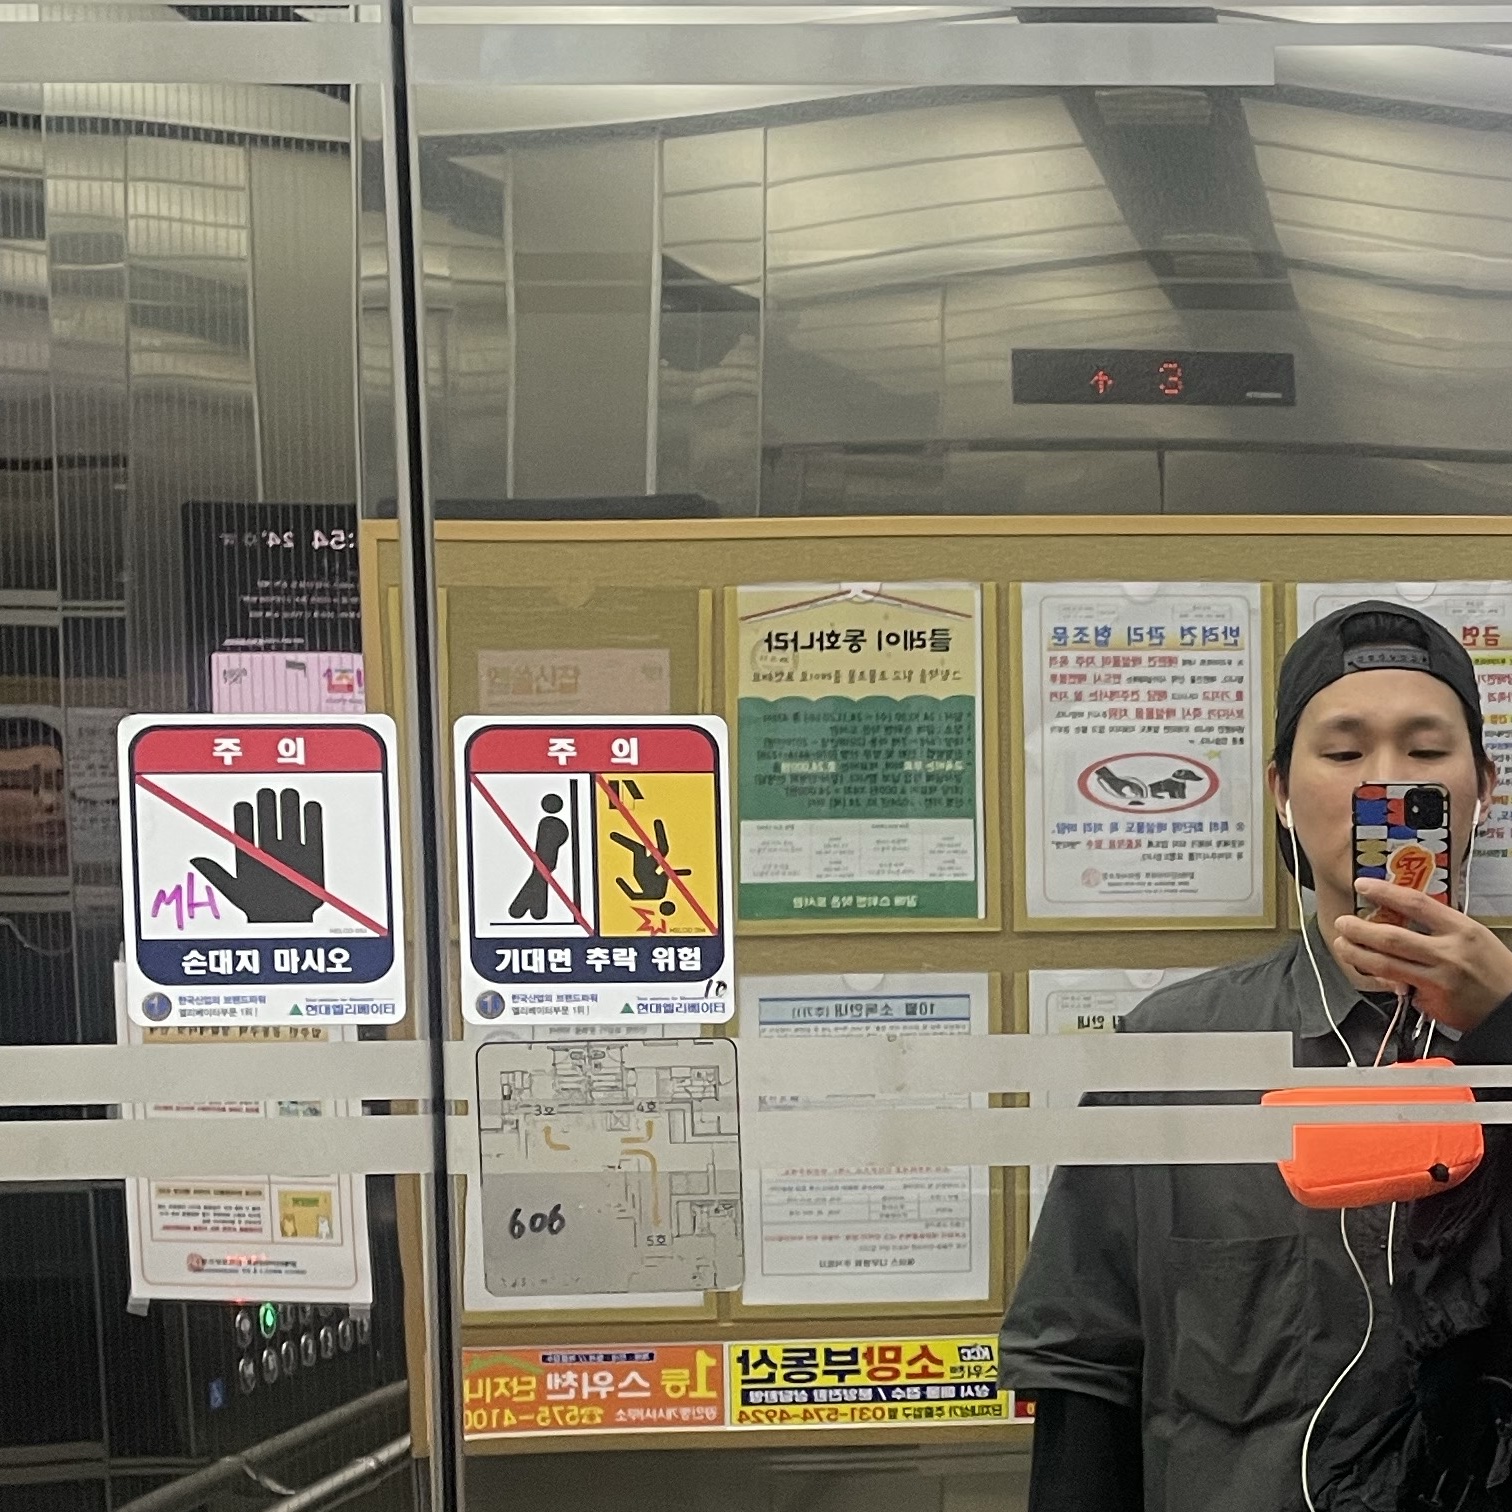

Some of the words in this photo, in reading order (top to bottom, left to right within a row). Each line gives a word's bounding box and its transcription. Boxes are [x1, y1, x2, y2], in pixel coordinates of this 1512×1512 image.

[152, 872, 220, 930] MH
[182, 948, 260, 975] 손대지
[274, 948, 352, 973] 마시오
[495, 948, 572, 974] 기대면
[586, 947, 637, 972] 추락
[651, 947, 702, 971] 위험
[306, 1004, 395, 1016] 현대엘리베이터
[637, 1003, 725, 1014] 현대엘리베이터
[637, 1101, 657, 1113] 4호
[509, 1204, 566, 1240] 606
[647, 1234, 667, 1246] 5호
